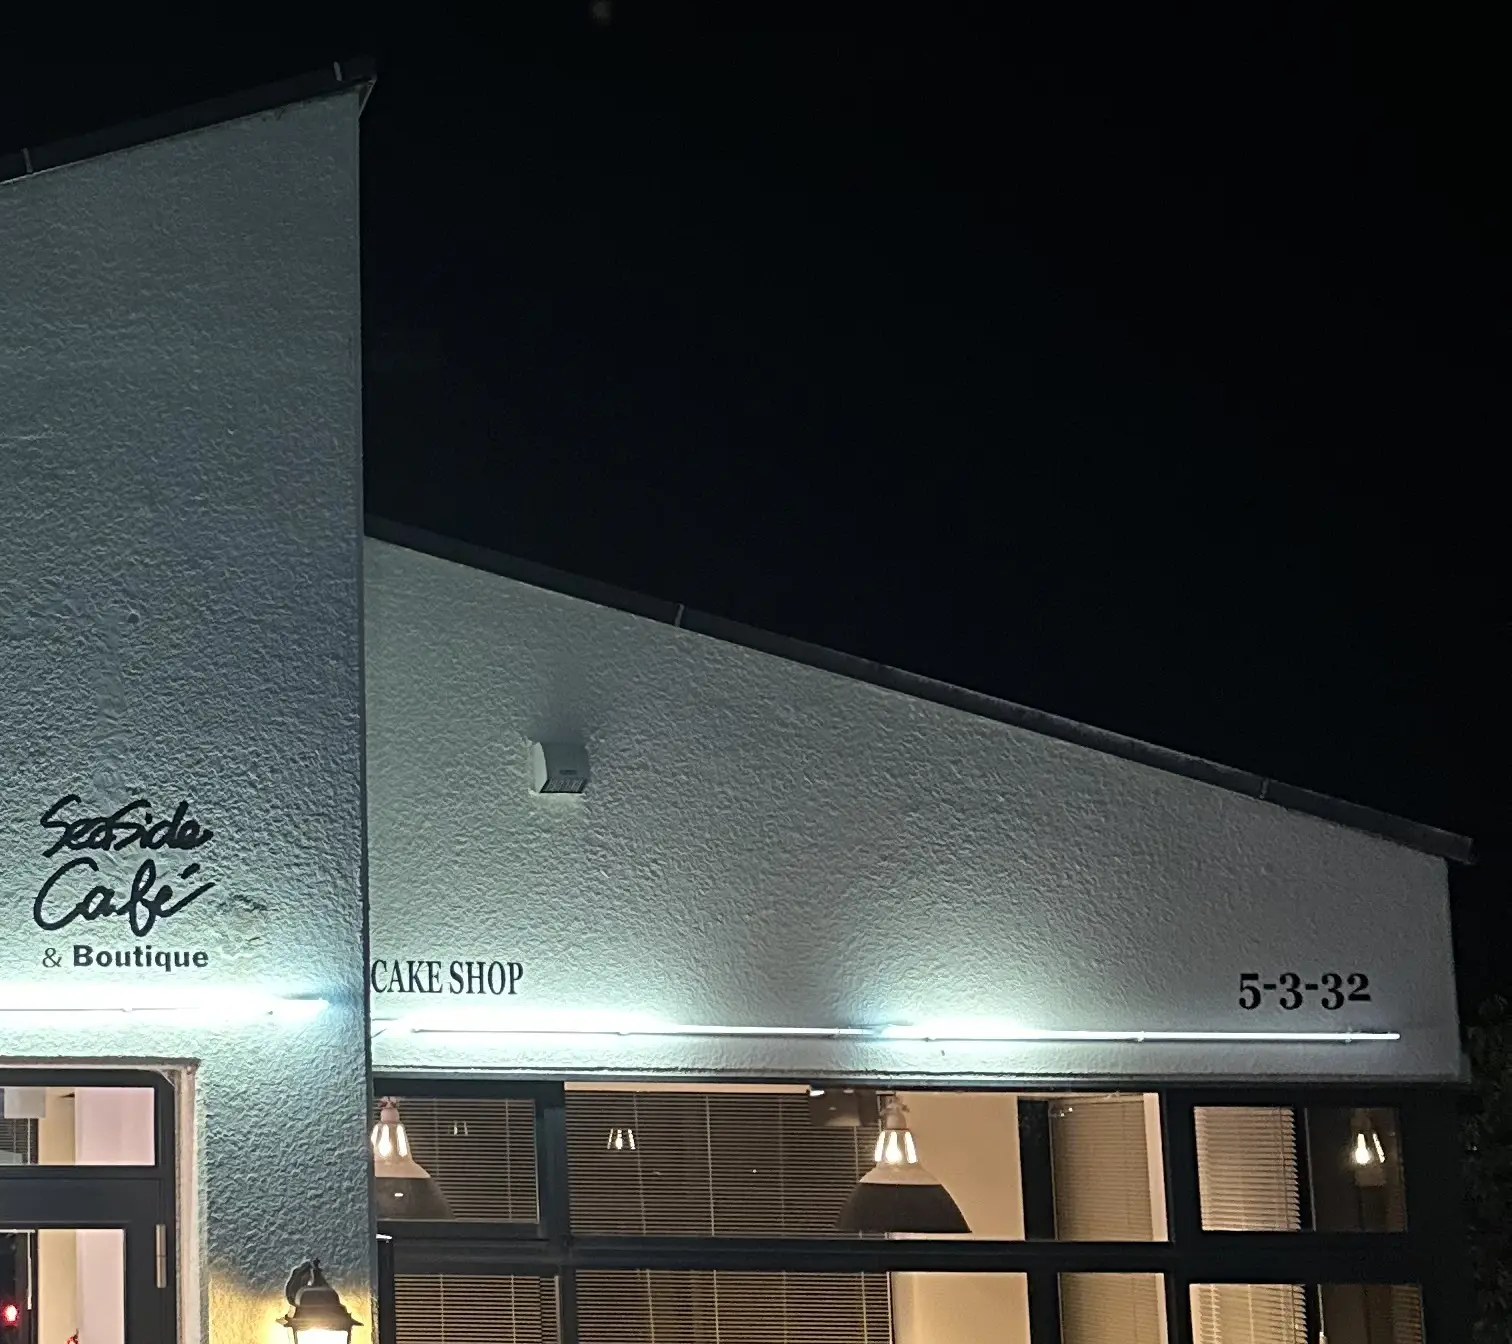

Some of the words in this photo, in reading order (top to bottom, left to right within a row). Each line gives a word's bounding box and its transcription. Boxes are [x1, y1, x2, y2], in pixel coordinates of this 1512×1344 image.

[33, 857, 216, 937] Café
[42, 947, 62, 968] &
[73, 945, 209, 972] Boutique
[371, 959, 443, 993] CAKE
[449, 960, 523, 995] SHOP
[1239, 972, 1372, 1010] 5-3-32
